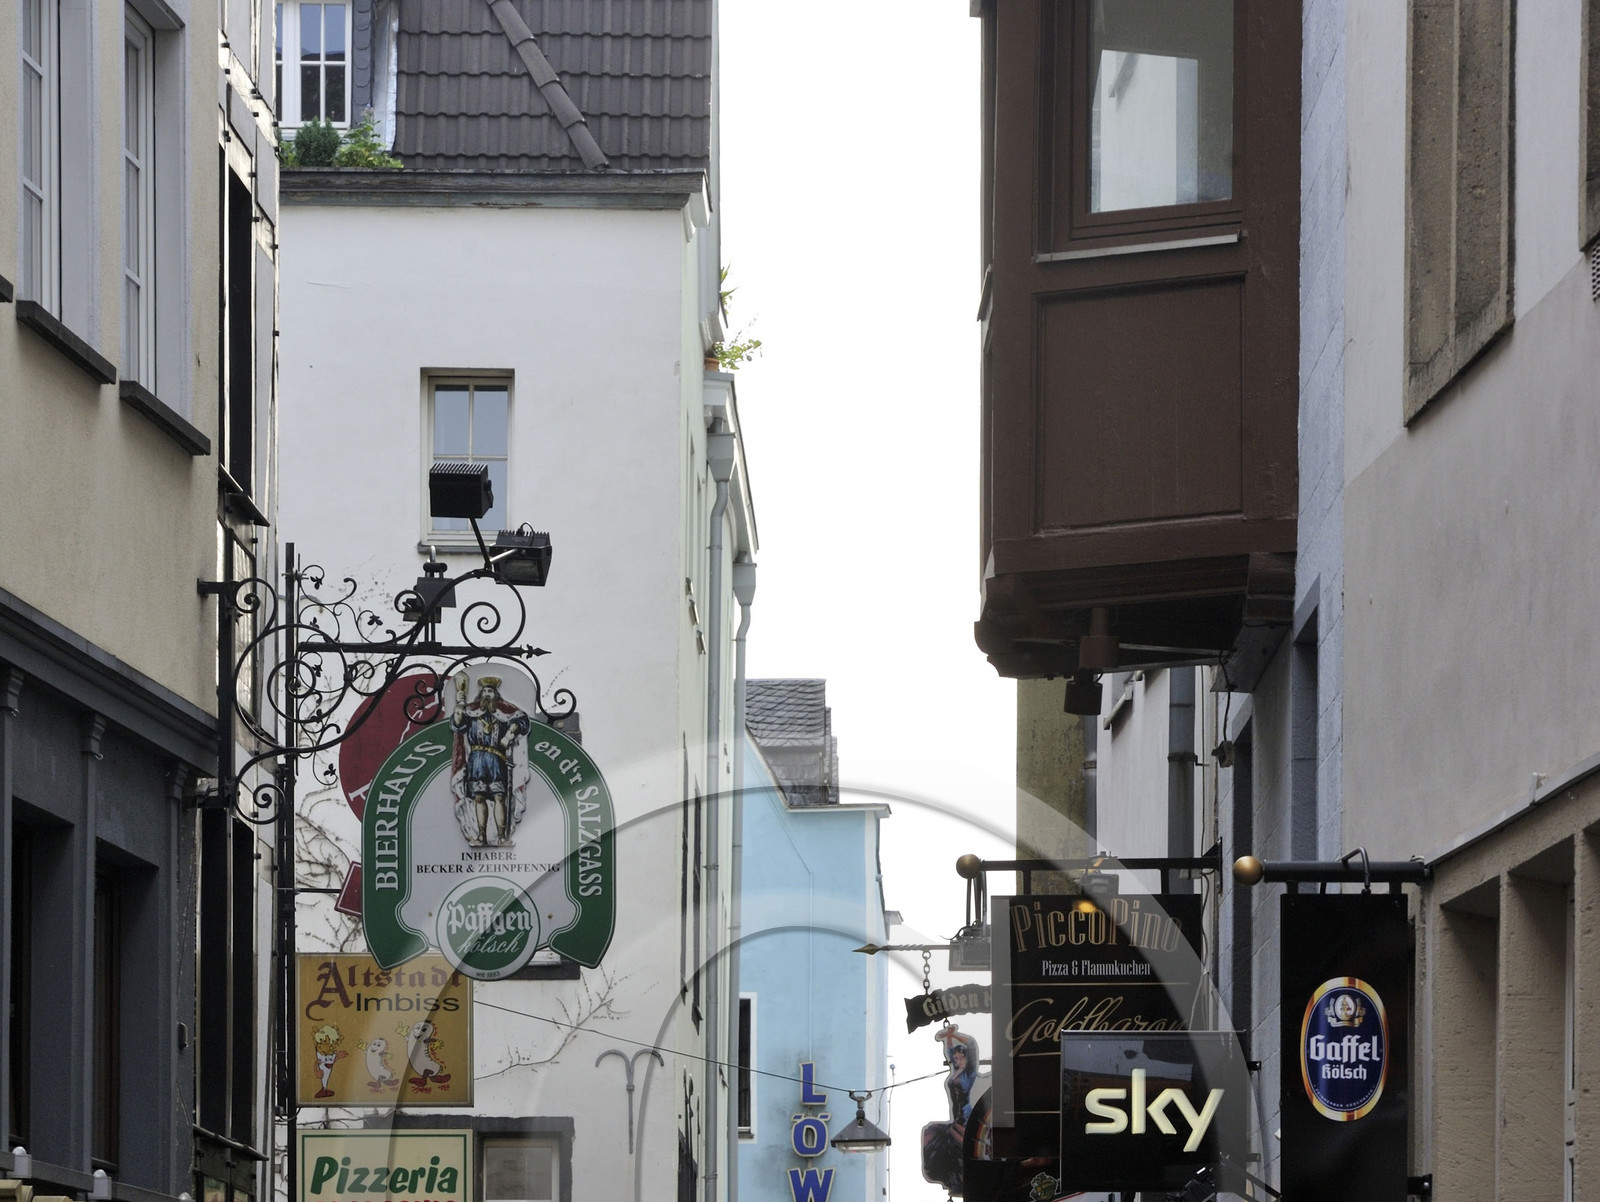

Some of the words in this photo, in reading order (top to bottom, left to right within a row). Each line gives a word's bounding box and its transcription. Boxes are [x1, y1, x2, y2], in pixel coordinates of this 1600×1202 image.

[375, 741, 447, 891] BIERHAUS
[534, 741, 562, 761] en
[575, 785, 603, 897] SALZGASS
[416, 864, 463, 874] BECKER
[466, 864, 475, 873] &
[478, 863, 560, 873] ZEHNPFENNIG
[461, 851, 517, 861] INHABER:
[447, 901, 533, 936] Päffgen
[1042, 960, 1069, 976] Pizza
[1072, 960, 1079, 976] &
[1081, 960, 1151, 976] Flammkuchen
[305, 961, 463, 1021] Altstadt
[356, 993, 460, 1012] Imbiss
[922, 992, 979, 1017] Gilden
[1309, 1034, 1381, 1064] Gaffel
[1321, 1063, 1367, 1081] Kölsch
[1085, 1068, 1225, 1152] sky
[310, 1156, 459, 1195] Pizzeria
